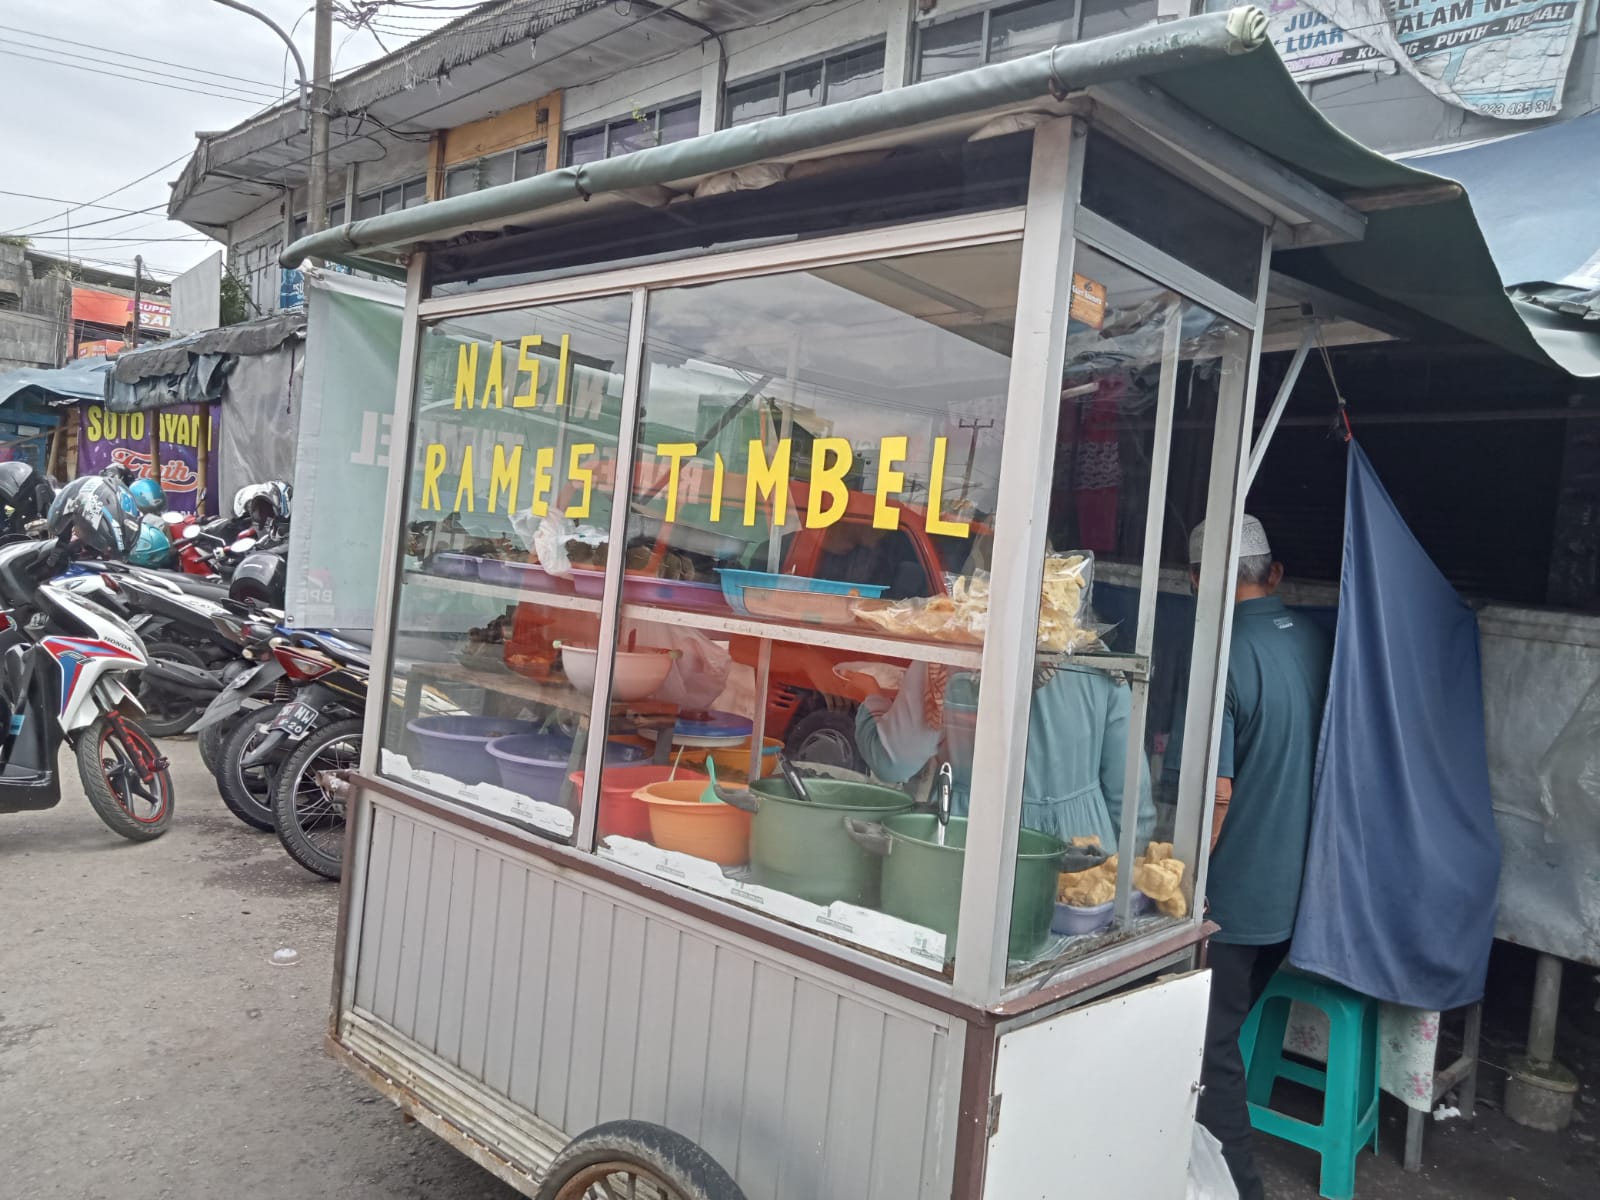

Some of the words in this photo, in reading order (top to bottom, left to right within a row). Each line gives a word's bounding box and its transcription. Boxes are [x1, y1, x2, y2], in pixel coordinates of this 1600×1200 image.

[1284, 11, 1330, 33] JUA
[1396, 3, 1473, 35] ALAM
[1286, 27, 1344, 53] LUAR
[1434, 25, 1489, 48] PUTIH
[454, 334, 569, 410] NASI
[421, 443, 595, 518] RAMES
[656, 436, 970, 538] TIMBEL
[104, 636, 131, 652] HONDA
